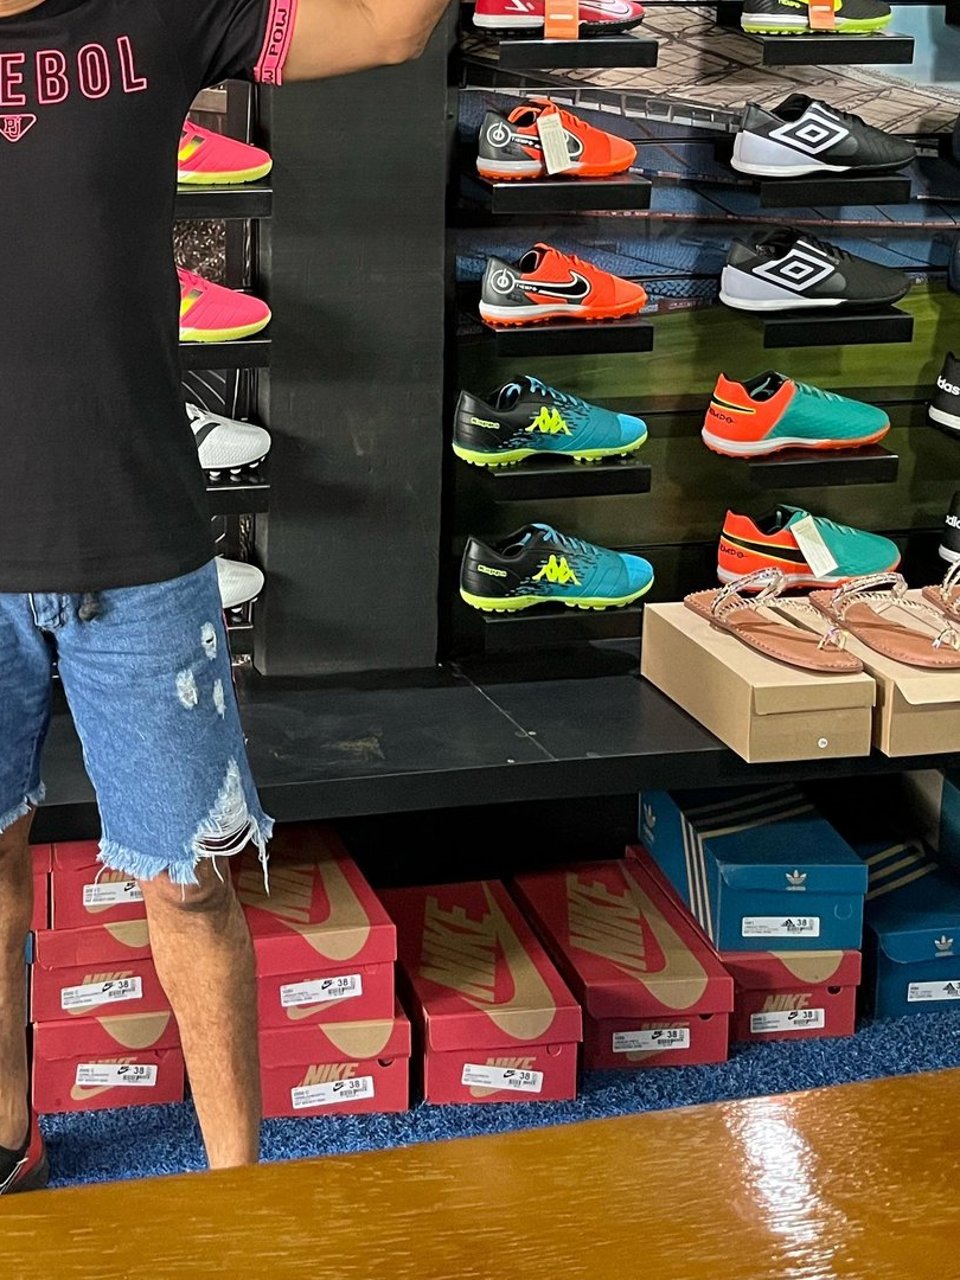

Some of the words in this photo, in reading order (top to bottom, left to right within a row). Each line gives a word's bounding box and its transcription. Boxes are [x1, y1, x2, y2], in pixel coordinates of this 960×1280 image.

[118, 980, 129, 989] 38
[337, 979, 348, 987] 38
[133, 1067, 144, 1075] 38
[520, 1072, 531, 1080] 38
[349, 1080, 360, 1088] 38
